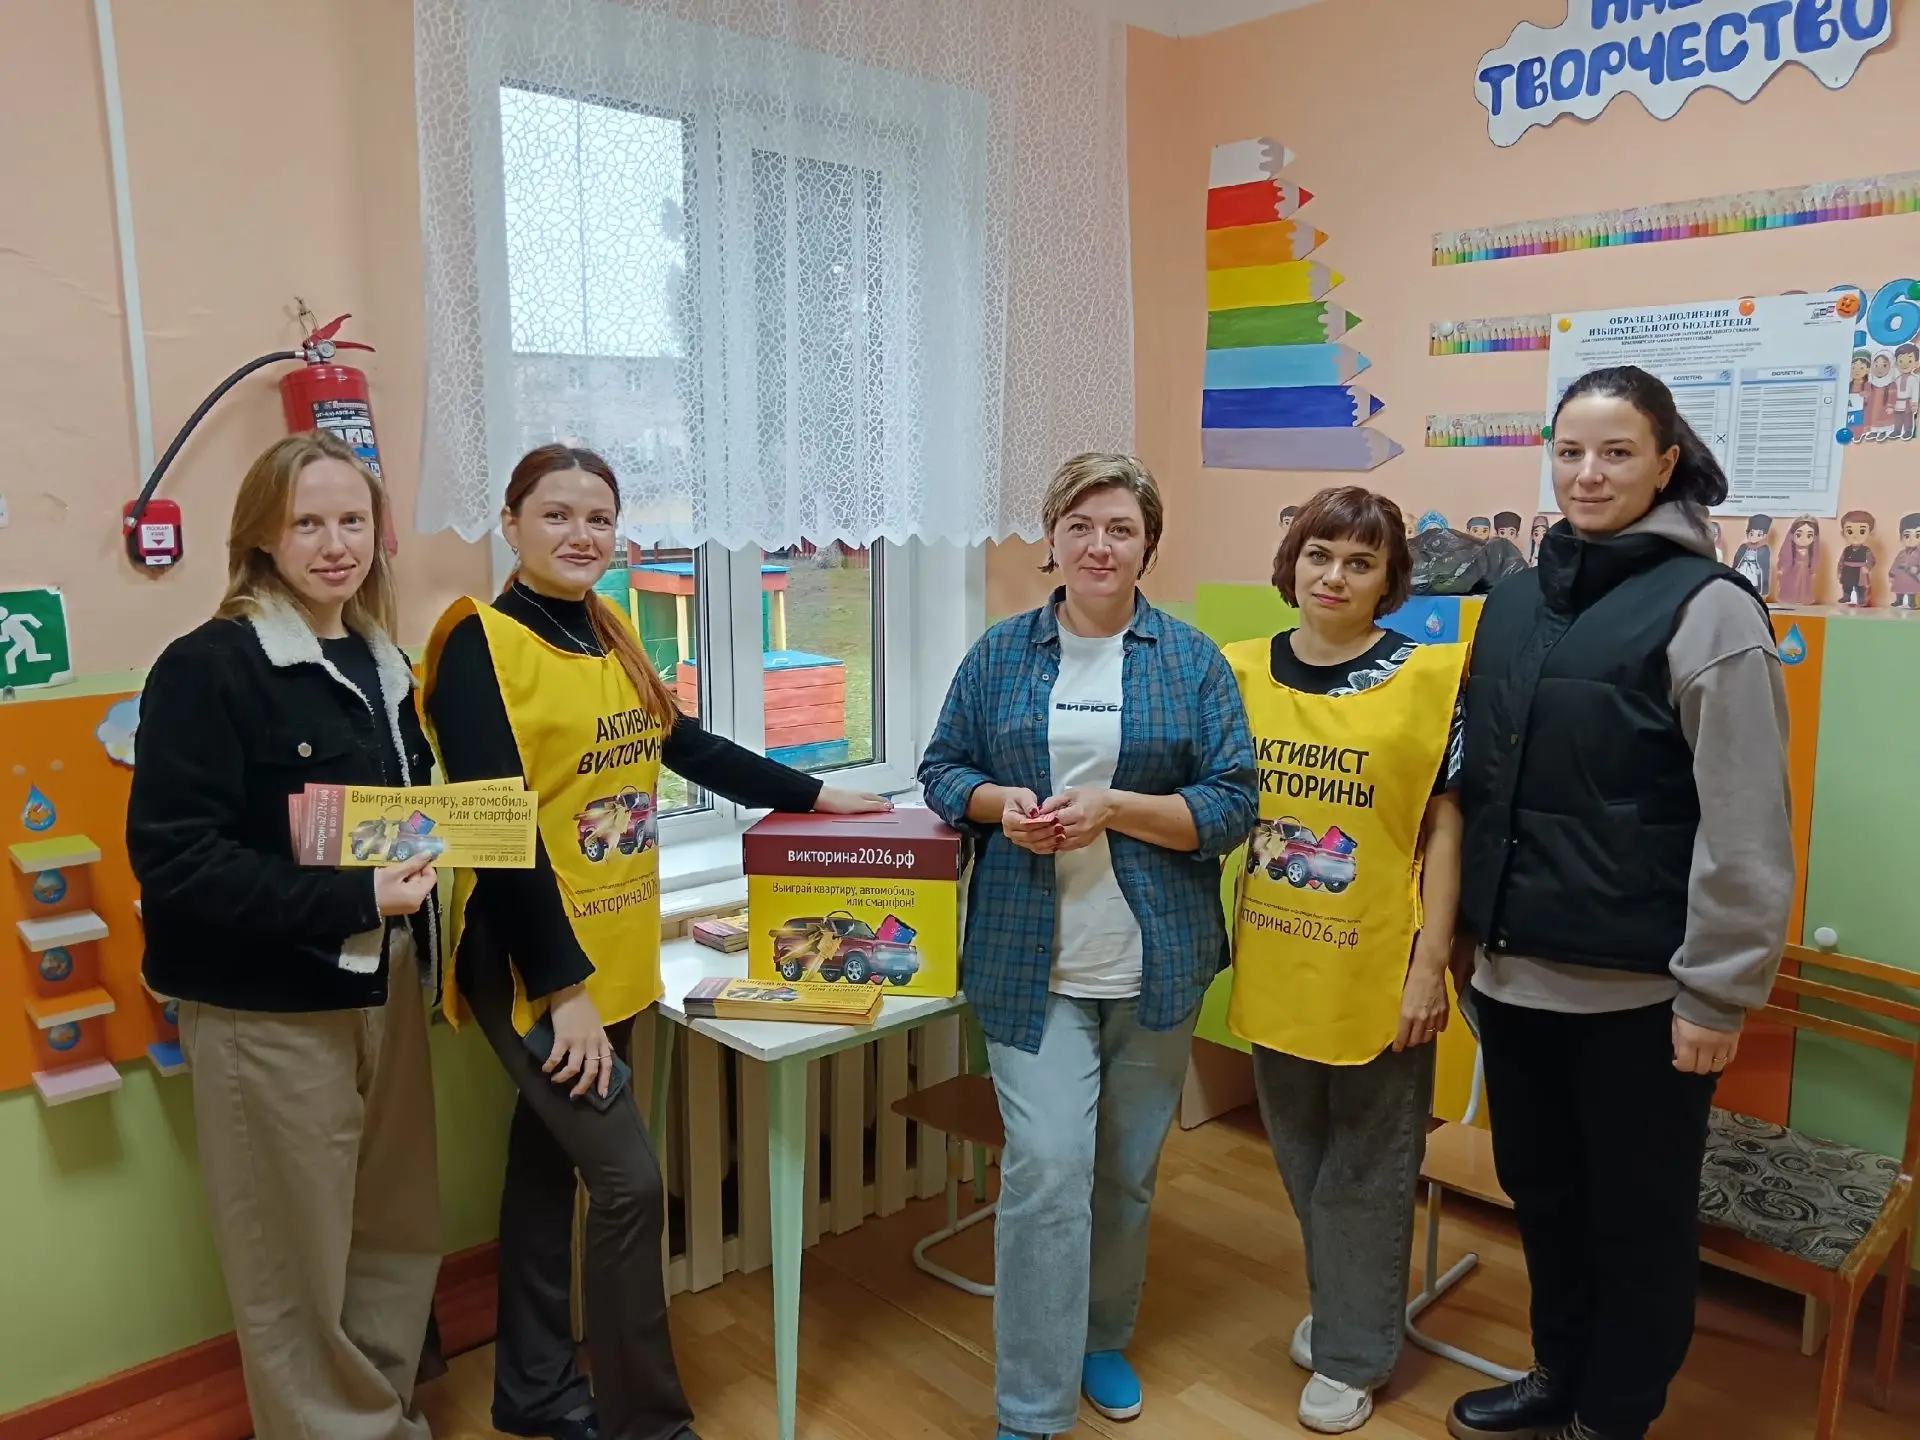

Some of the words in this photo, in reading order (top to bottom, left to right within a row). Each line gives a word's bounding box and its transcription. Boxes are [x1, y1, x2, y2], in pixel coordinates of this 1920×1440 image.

[1478, 0, 1888, 116] ТВОРЧЕСТВО
[1609, 314, 1655, 325] ОБРАЗЕЦ
[1657, 309, 1730, 322] ЗАПОЛНЕНИЯ
[1588, 323, 1680, 336] ИЗБИРАТЕЛЬНОГО
[1682, 317, 1752, 330] БЮЛЛЕТЕНЯ
[577, 736, 661, 775] ВИКТОРИН
[1257, 768, 1375, 808] КТОРИНЫ
[352, 790, 401, 806] Выиграй
[405, 794, 458, 808] квартиру,
[462, 794, 528, 807] автомобиль
[449, 811, 469, 820] или
[473, 810, 532, 823] смартфон!
[788, 848, 915, 868] викторина2026.рф
[772, 882, 812, 895] Выиграй
[814, 885, 858, 896] квартиру,
[860, 885, 915, 896] автомобиль
[846, 898, 863, 907] или
[865, 898, 914, 909] смартфон!
